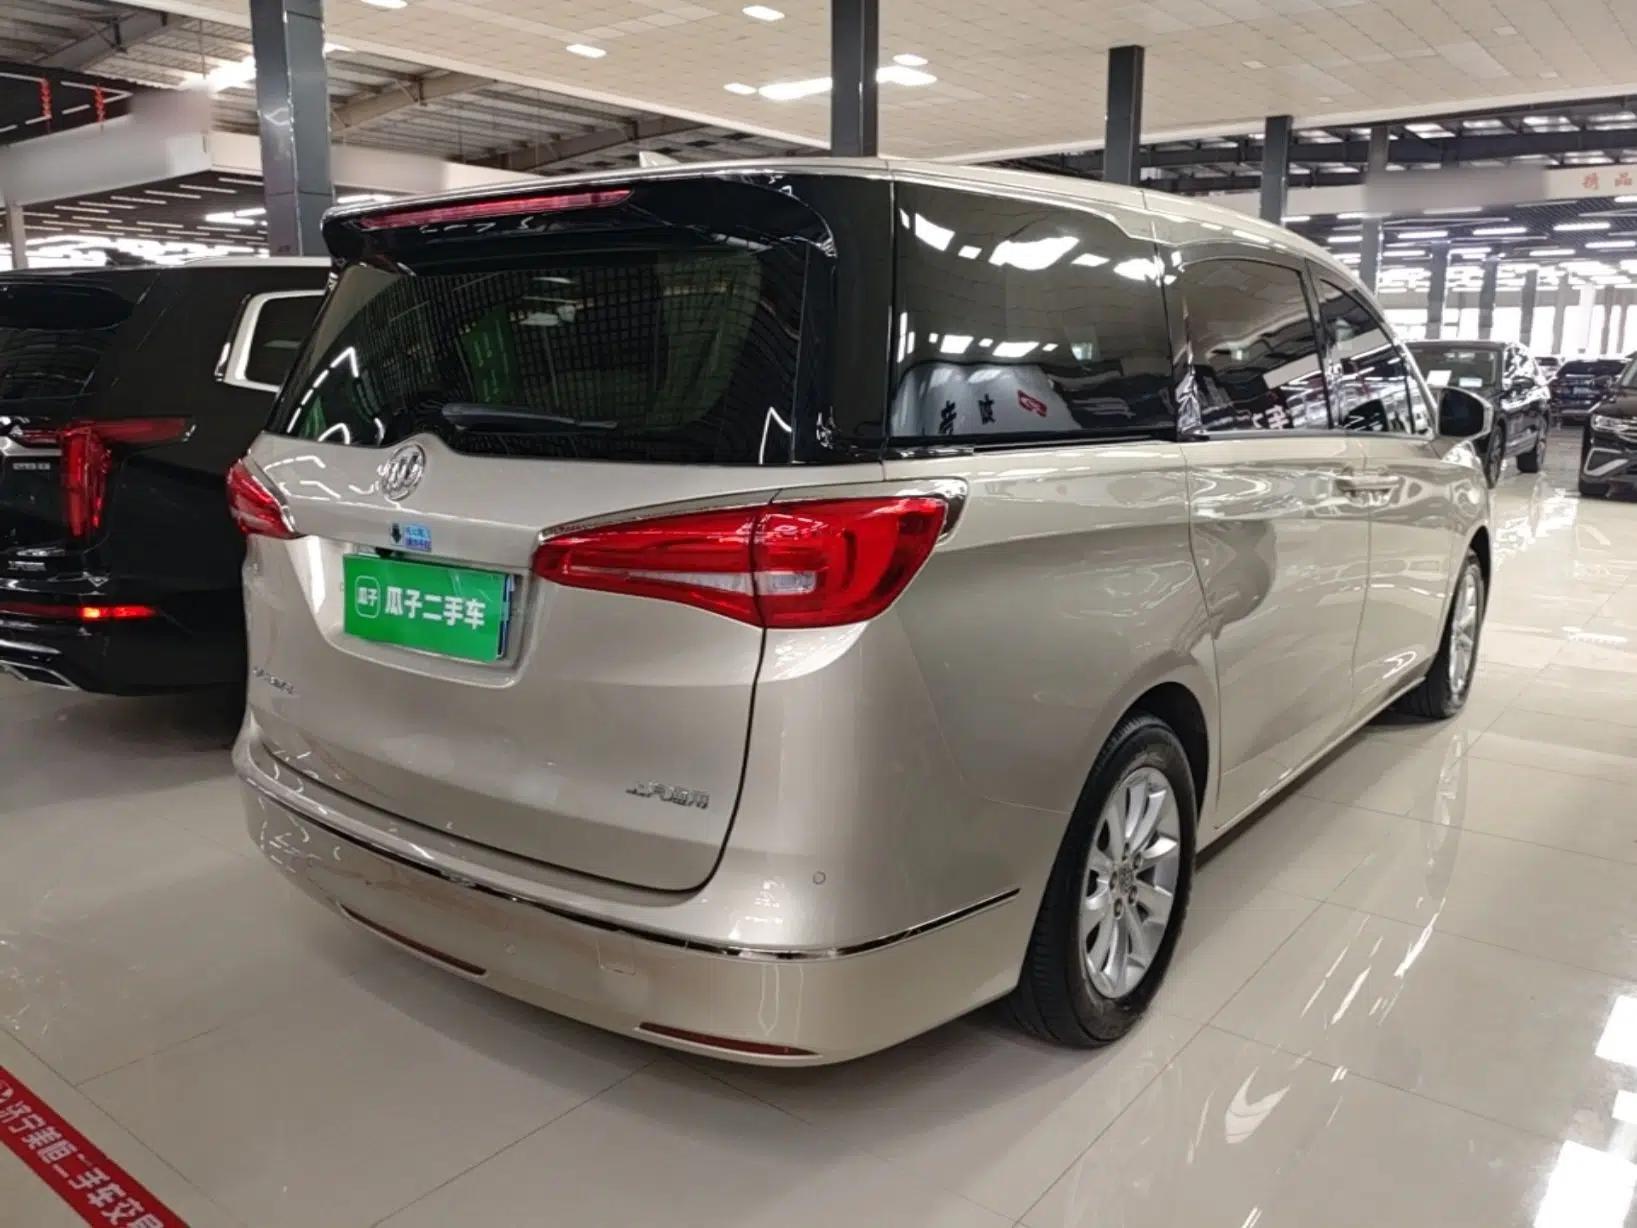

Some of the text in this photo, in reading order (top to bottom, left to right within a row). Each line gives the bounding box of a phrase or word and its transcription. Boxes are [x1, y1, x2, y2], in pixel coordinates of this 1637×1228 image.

[384, 585, 486, 630] 瓜子二手车
